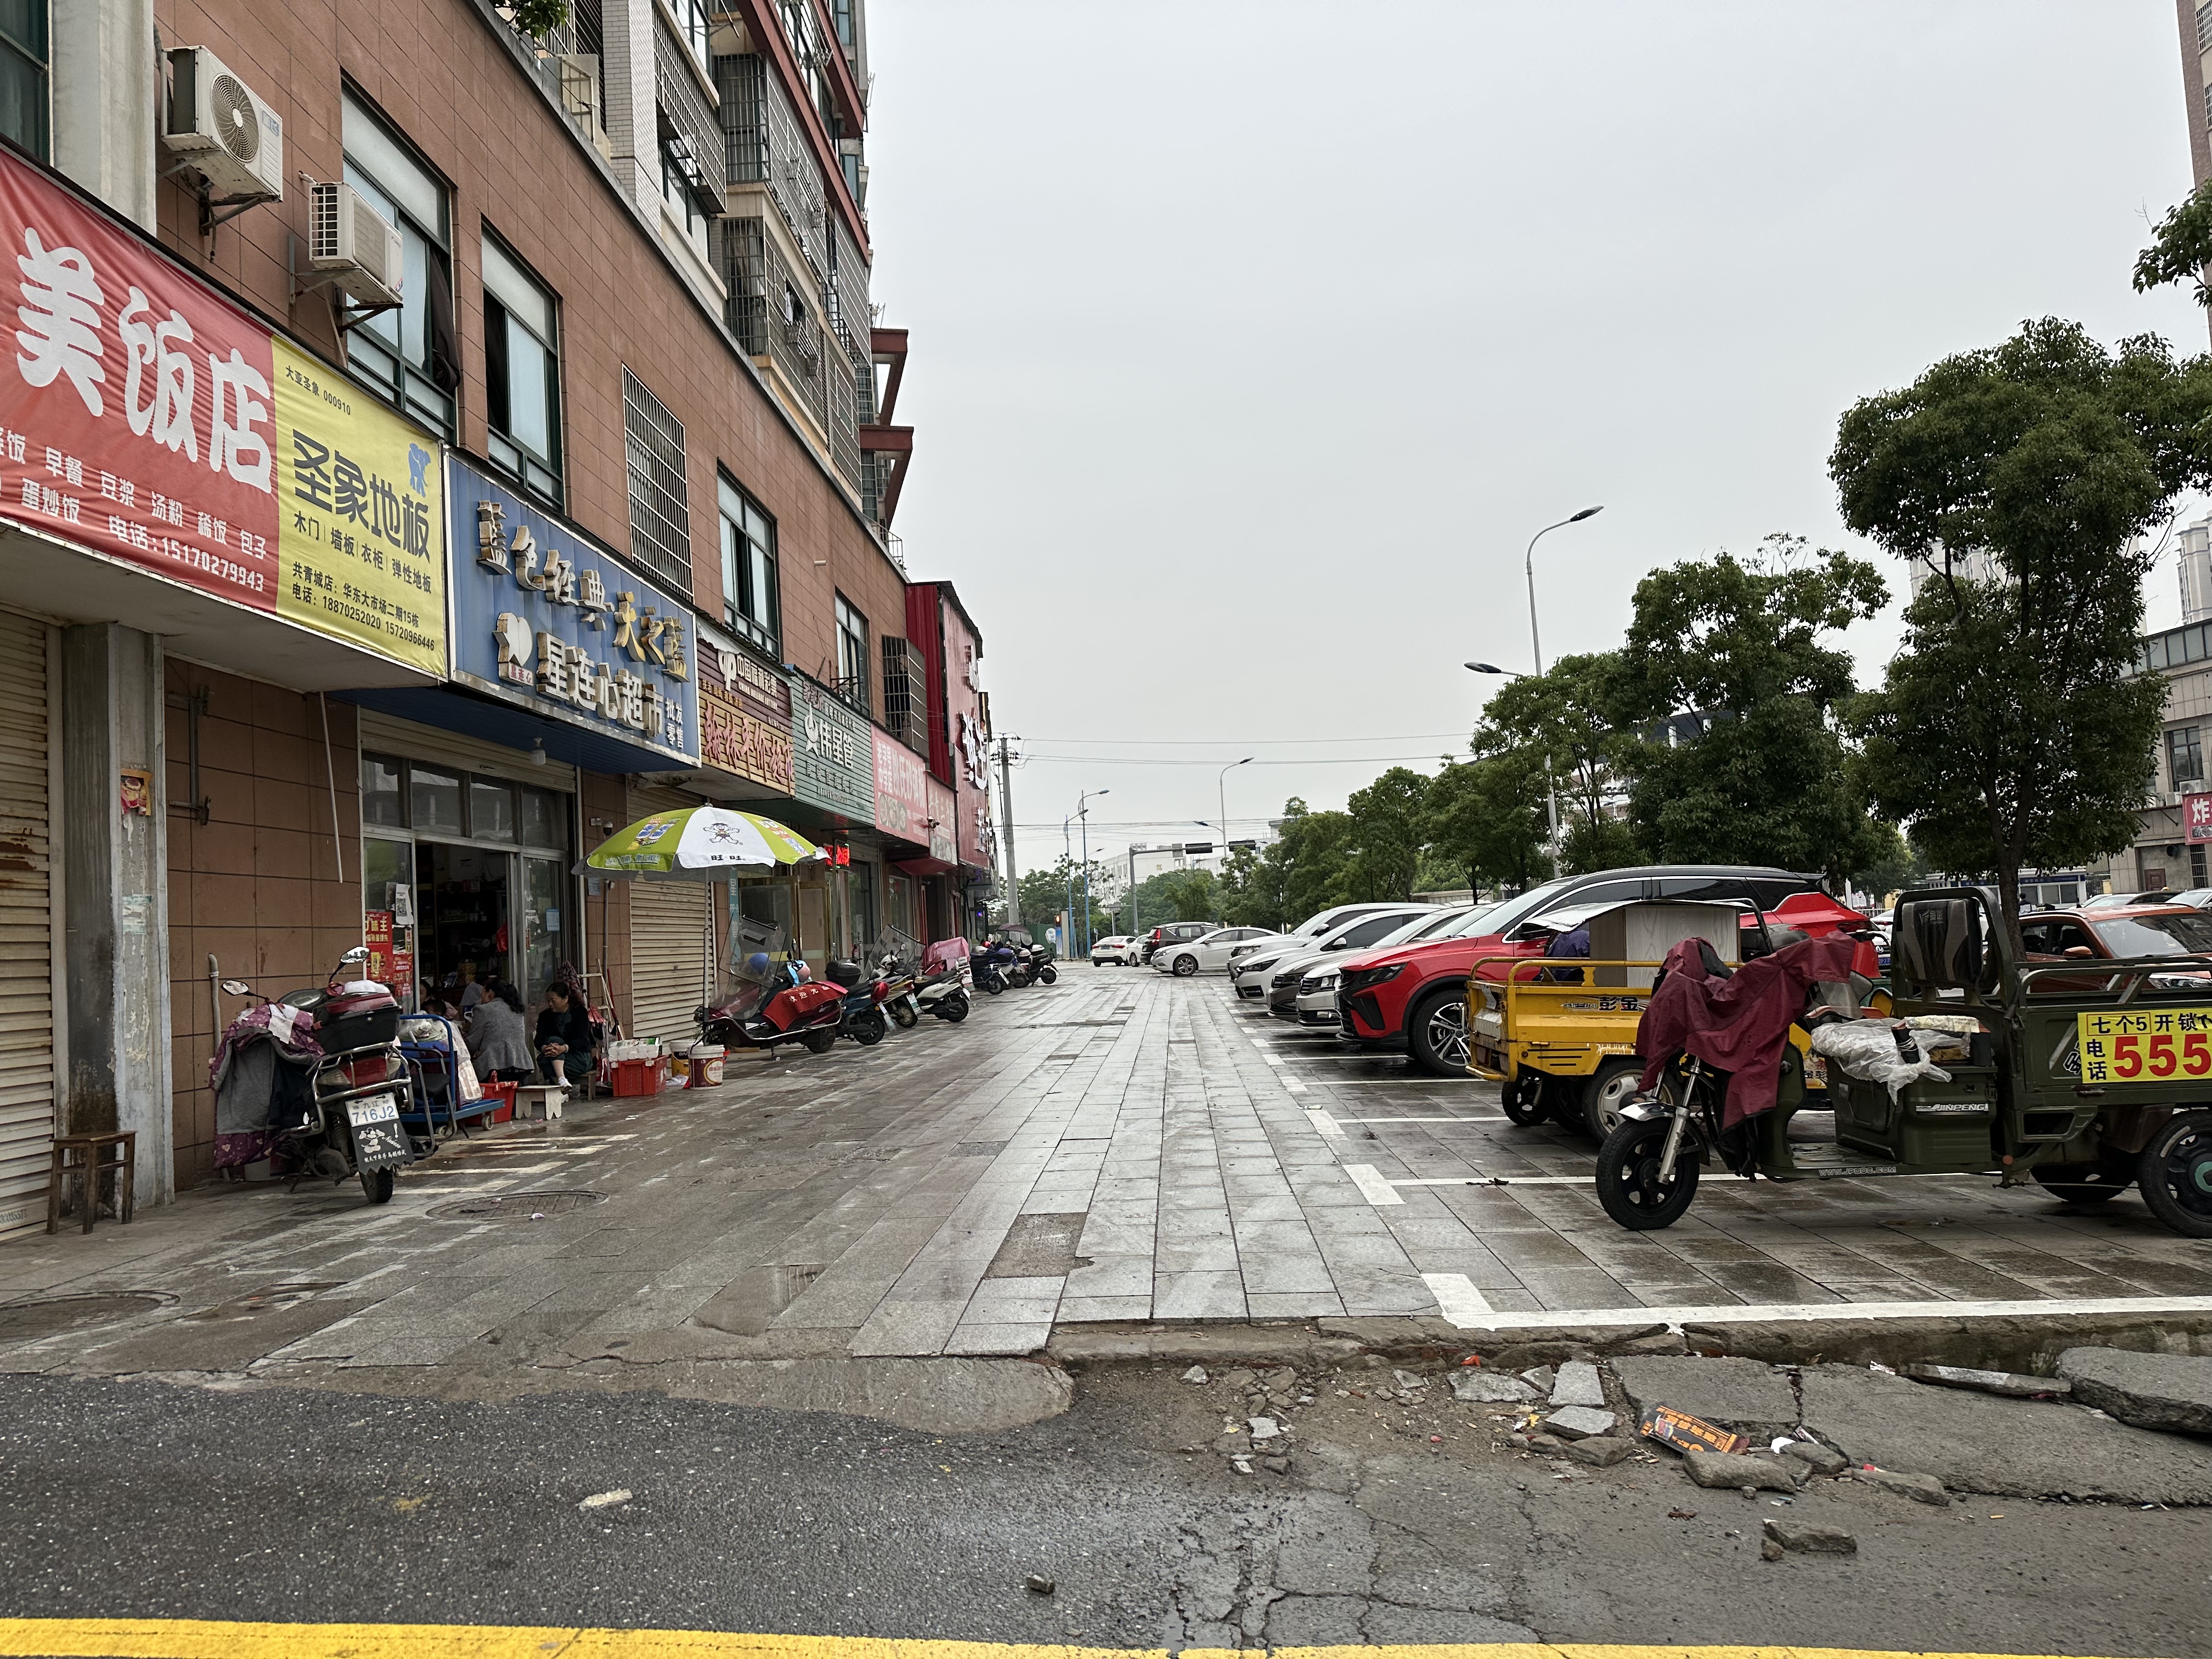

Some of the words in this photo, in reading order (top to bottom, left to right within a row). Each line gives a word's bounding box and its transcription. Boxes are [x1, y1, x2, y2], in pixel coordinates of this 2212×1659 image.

[16, 227, 272, 494] 美饭店
[285, 365, 319, 396] 大亚圣象
[323, 390, 351, 415] 000910
[21, 478, 81, 525] 蛋炒饭
[46, 446, 83, 487] 早餐
[101, 470, 135, 507] 豆浆
[151, 491, 183, 527] 汤粉
[198, 511, 227, 545] 稀饭
[240, 529, 267, 560] 包子
[292, 428, 431, 564] 圣象地板
[294, 511, 319, 540] 木门
[331, 527, 354, 557] 墙板
[361, 543, 383, 571] 衣柜
[392, 558, 431, 594] 弹性地板
[385, 621, 435, 651] 15720966446
[537, 632, 665, 737] 星连心超市
[737, 654, 778, 698] 中国福利彩票
[819, 719, 853, 770] 伟星管
[2192, 797, 2212, 823] 炸
[2091, 1015, 2147, 1034] 七个5
[2086, 1039, 2107, 1080] 电话
[2114, 1033, 2211, 1078] 555
[352, 1105, 395, 1124] 716J2
